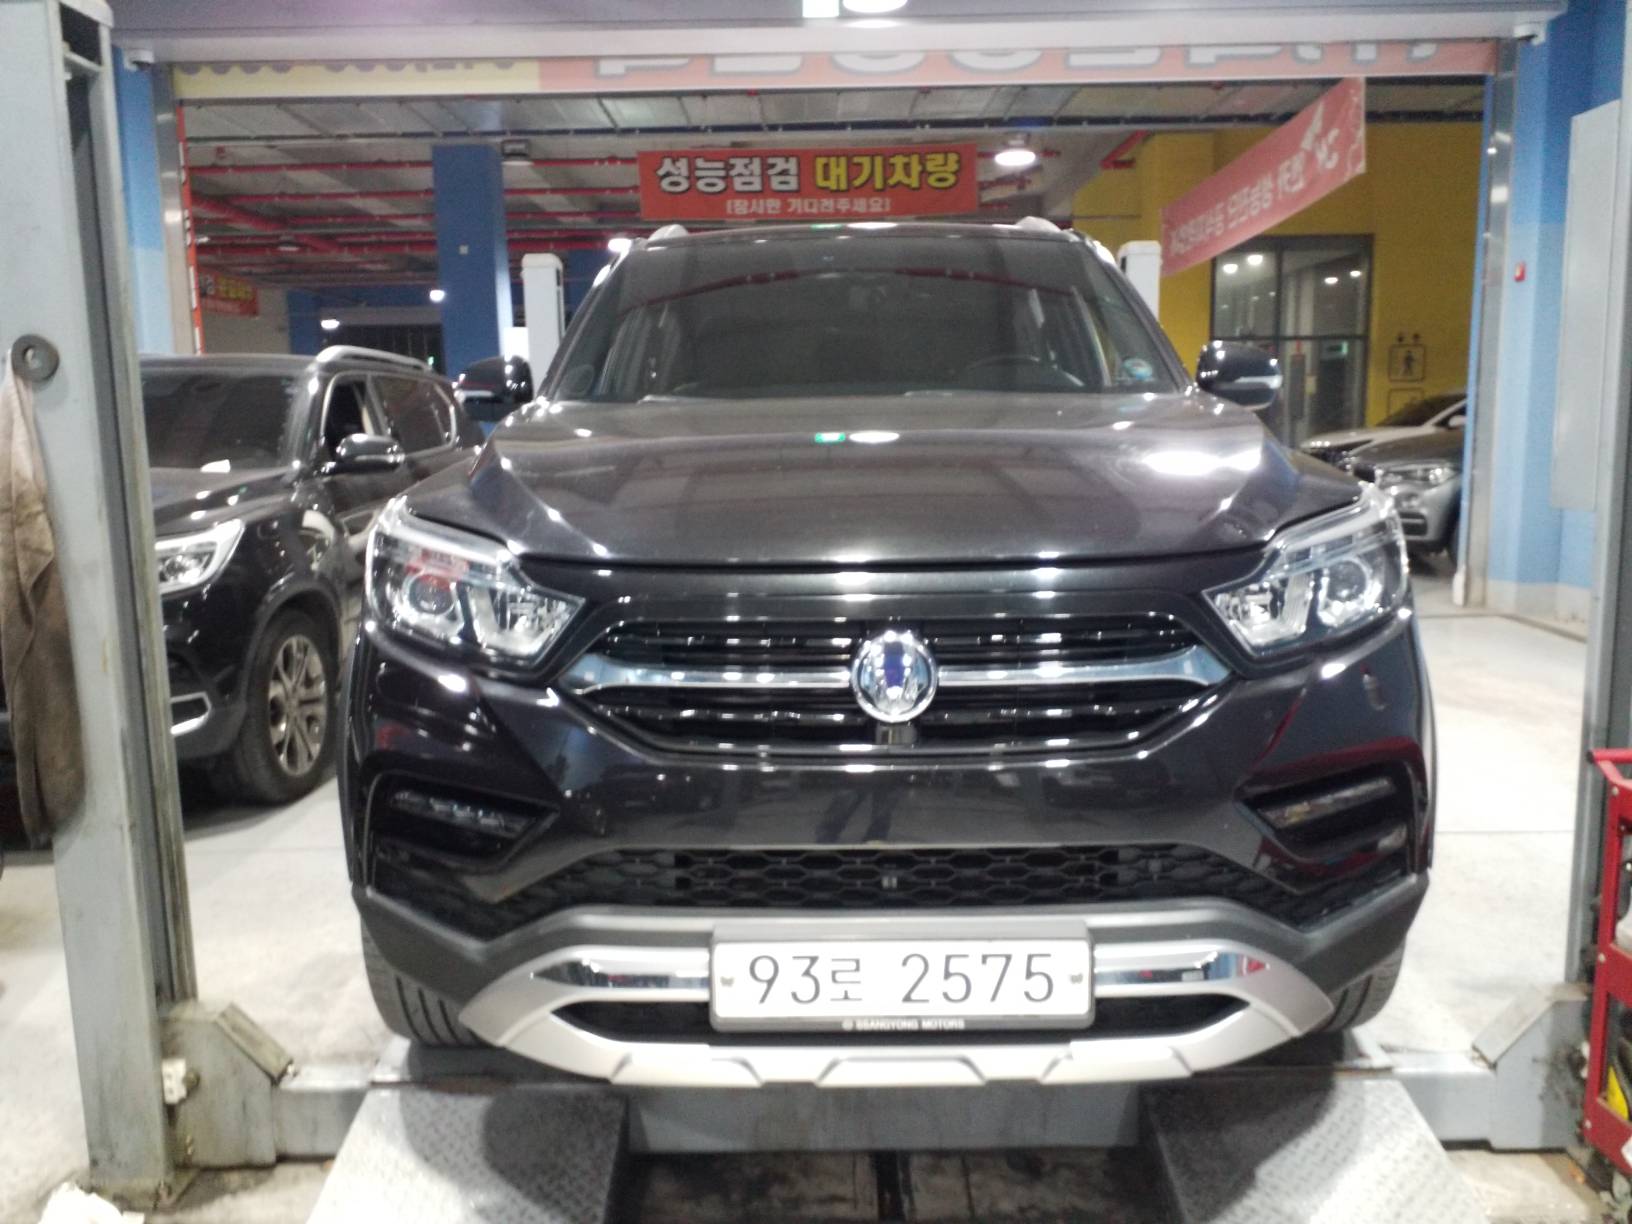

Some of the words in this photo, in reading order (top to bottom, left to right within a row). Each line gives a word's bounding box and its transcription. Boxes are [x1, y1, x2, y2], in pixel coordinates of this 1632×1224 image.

[656, 156, 800, 193] 성능점검
[814, 152, 961, 191] 대기차량
[749, 955, 862, 1004] 93로
[900, 953, 1054, 1003] 2575
[921, 1018, 965, 1031] MOTORS
